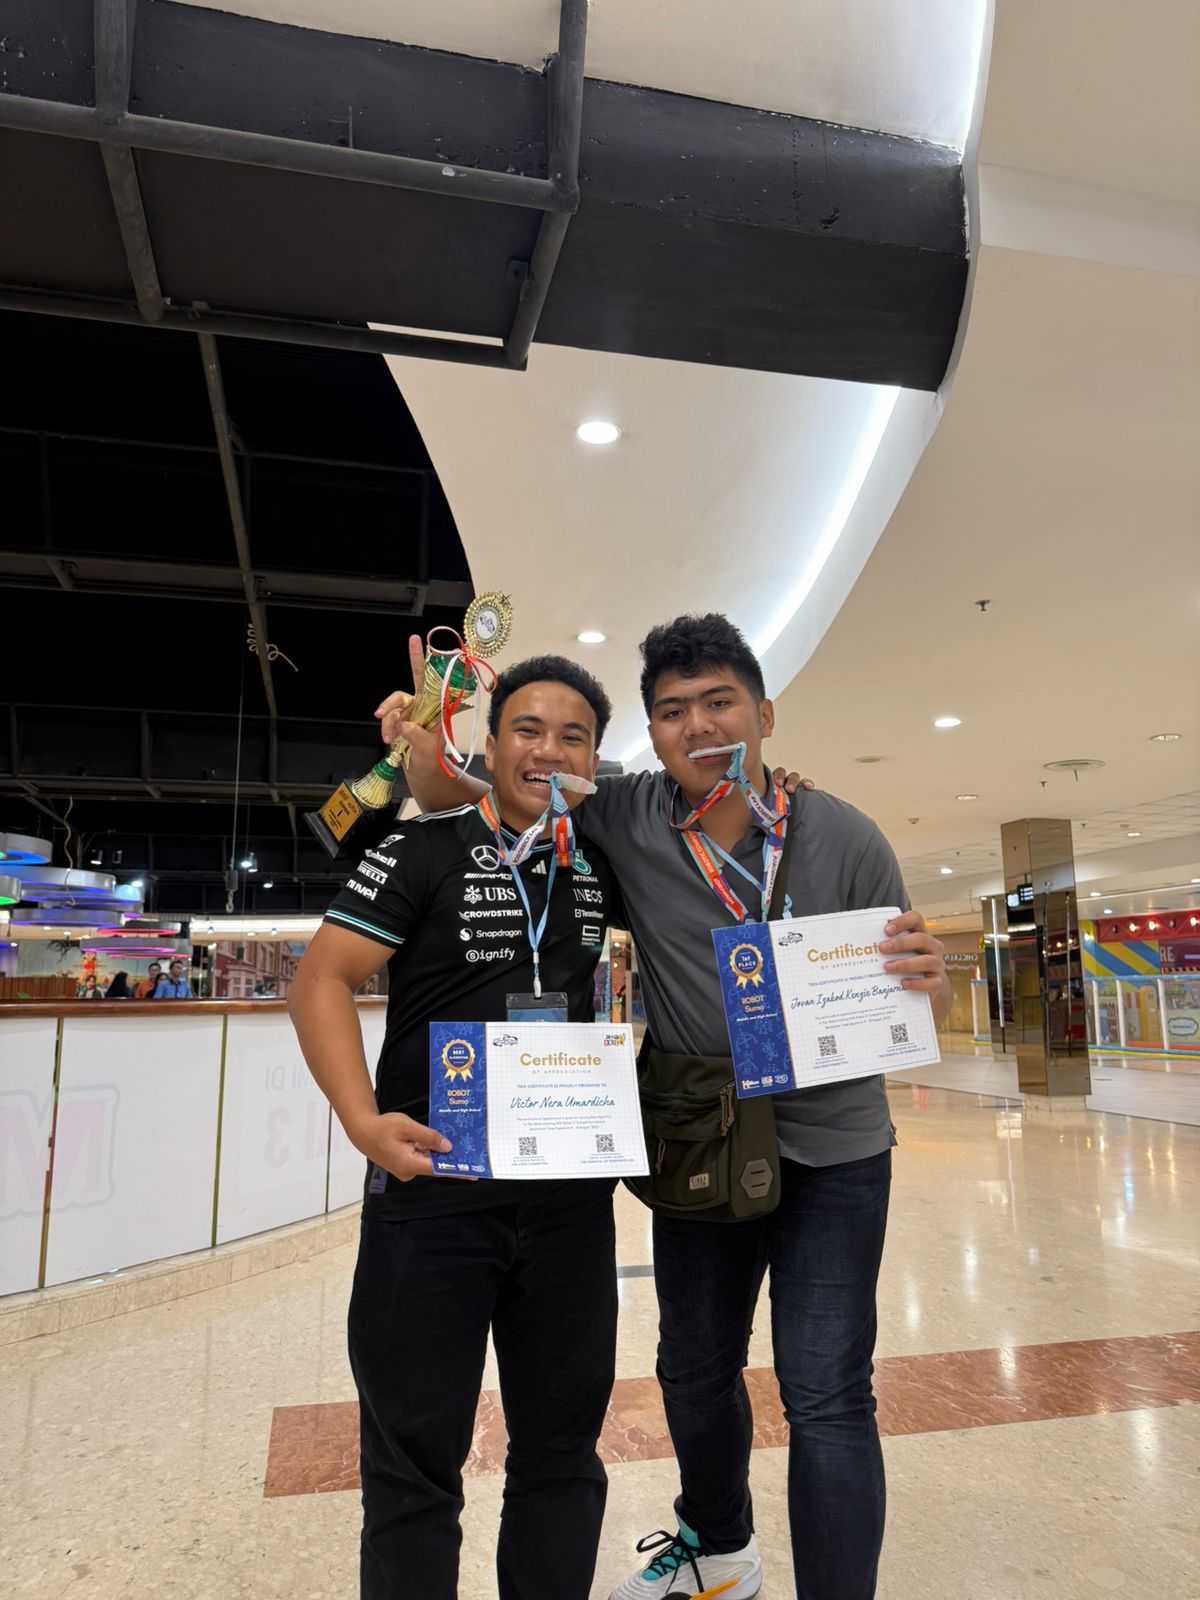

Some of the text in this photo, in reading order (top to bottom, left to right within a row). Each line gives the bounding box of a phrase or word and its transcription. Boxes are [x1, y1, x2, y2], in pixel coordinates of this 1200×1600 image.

[357, 860, 388, 885] PIRELLI
[346, 879, 378, 901] nuvei
[484, 887, 517, 901] UBS
[573, 888, 603, 904] INEOS
[463, 909, 524, 918] CROWDSTRIKE
[476, 929, 523, 938] Snapdragon
[807, 942, 880, 963] Certificat
[741, 995, 765, 1004] ROBOT
[790, 997, 815, 1009] Jovan
[845, 988, 871, 1004] Kenzie
[744, 1005, 764, 1013] Sumo
[520, 1052, 602, 1066] Certificate
[447, 1089, 471, 1097] ROBOT
[449, 1097, 469, 1105] Sumo
[510, 1096, 539, 1109] Victor
[540, 1096, 563, 1109] Nera
